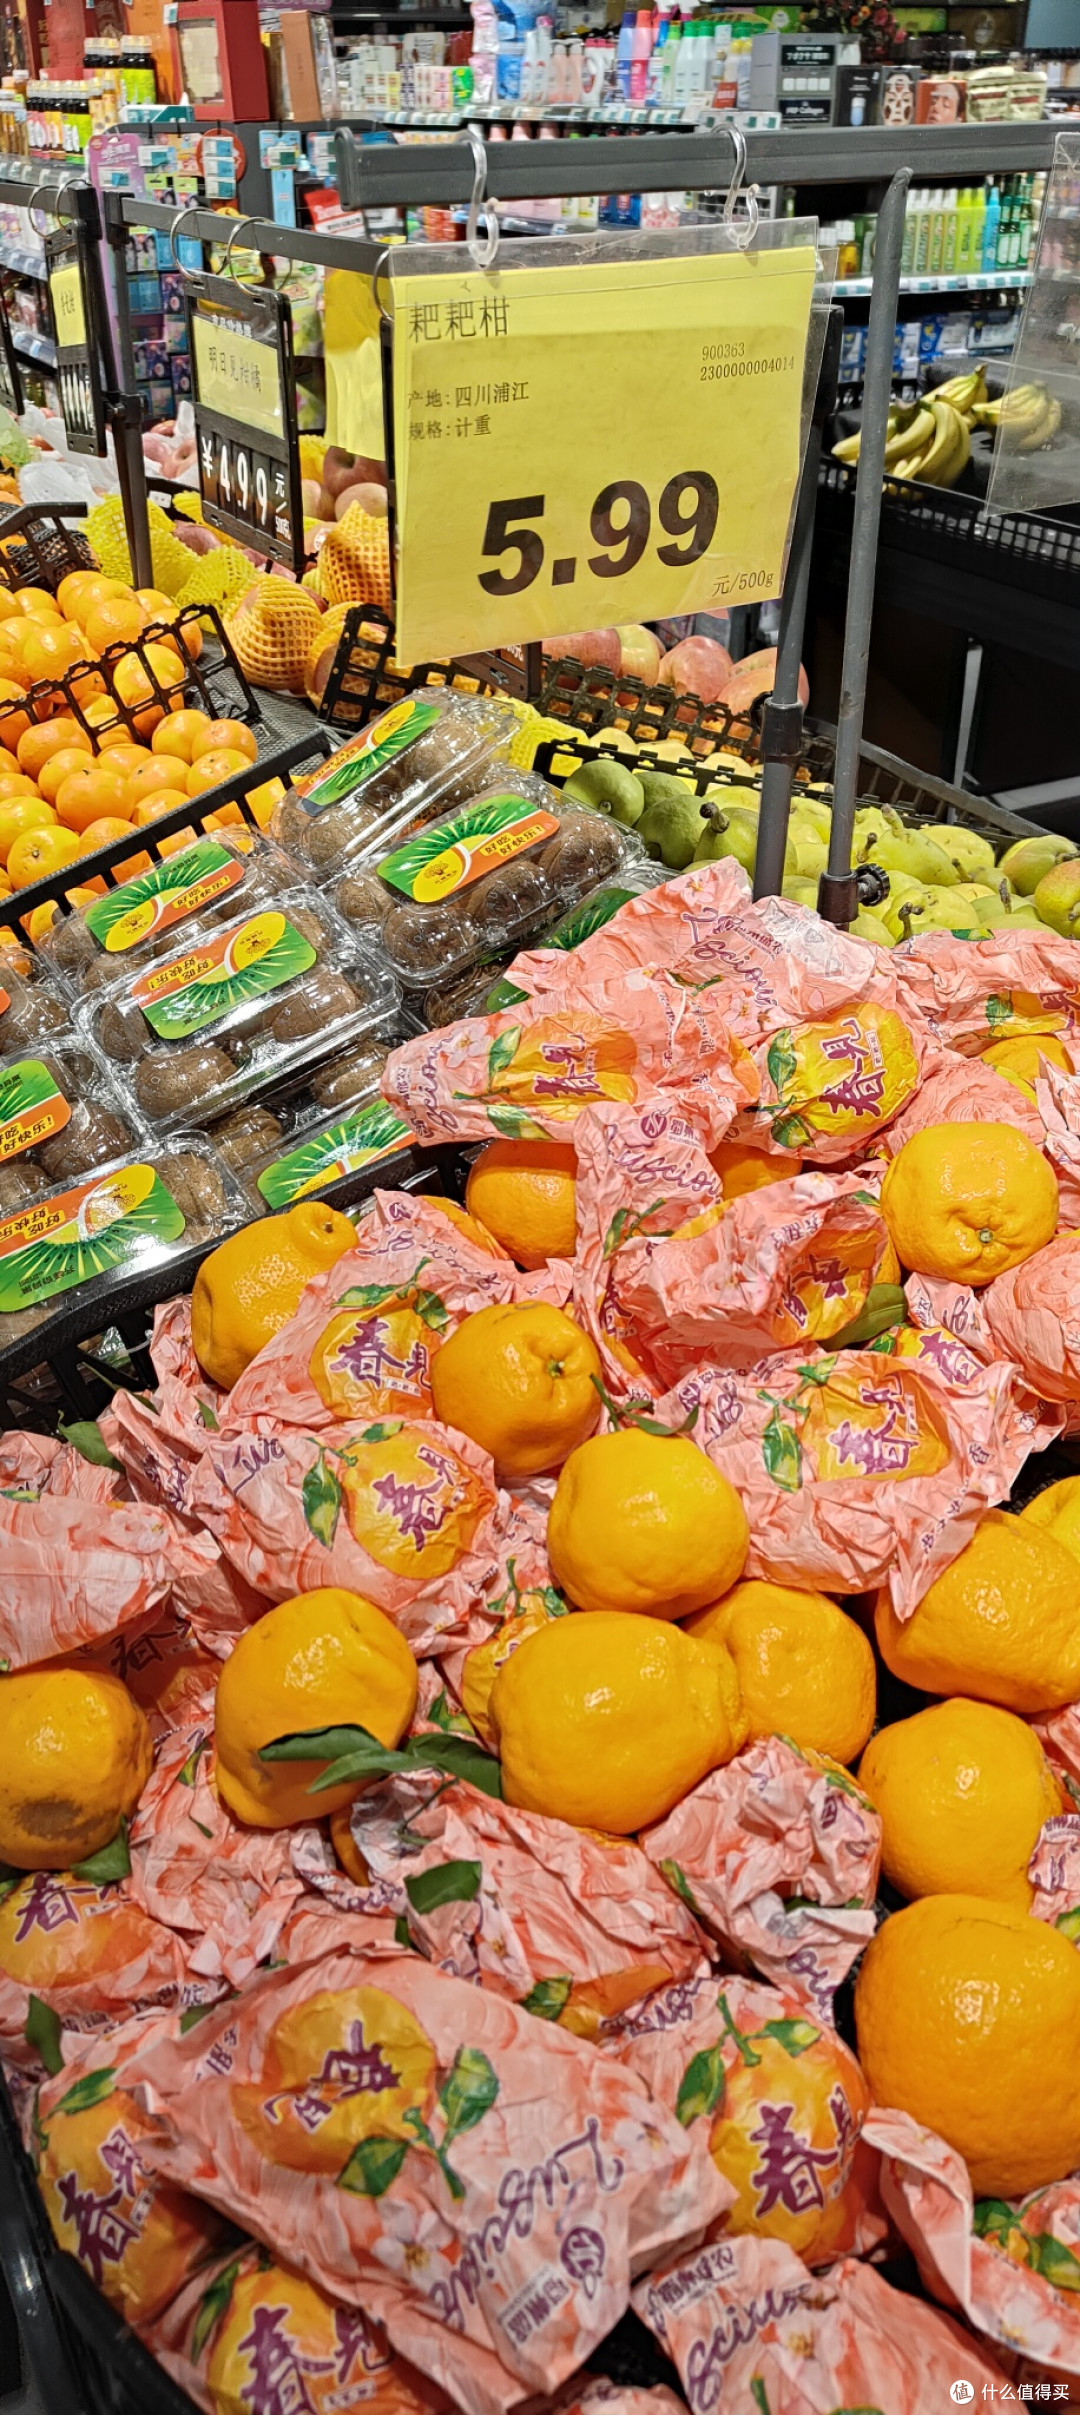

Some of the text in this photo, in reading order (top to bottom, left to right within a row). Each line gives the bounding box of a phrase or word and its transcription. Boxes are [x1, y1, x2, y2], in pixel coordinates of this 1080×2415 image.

[408, 296, 510, 343] 耙耙柑
[702, 342, 745, 361] 900363
[700, 356, 795, 381] 2300000004014
[408, 381, 529, 409] 产地:四川浦江
[408, 414, 492, 440] 规格:计重
[477, 470, 720, 596] 5.99
[712, 570, 774, 597] 元/500g
